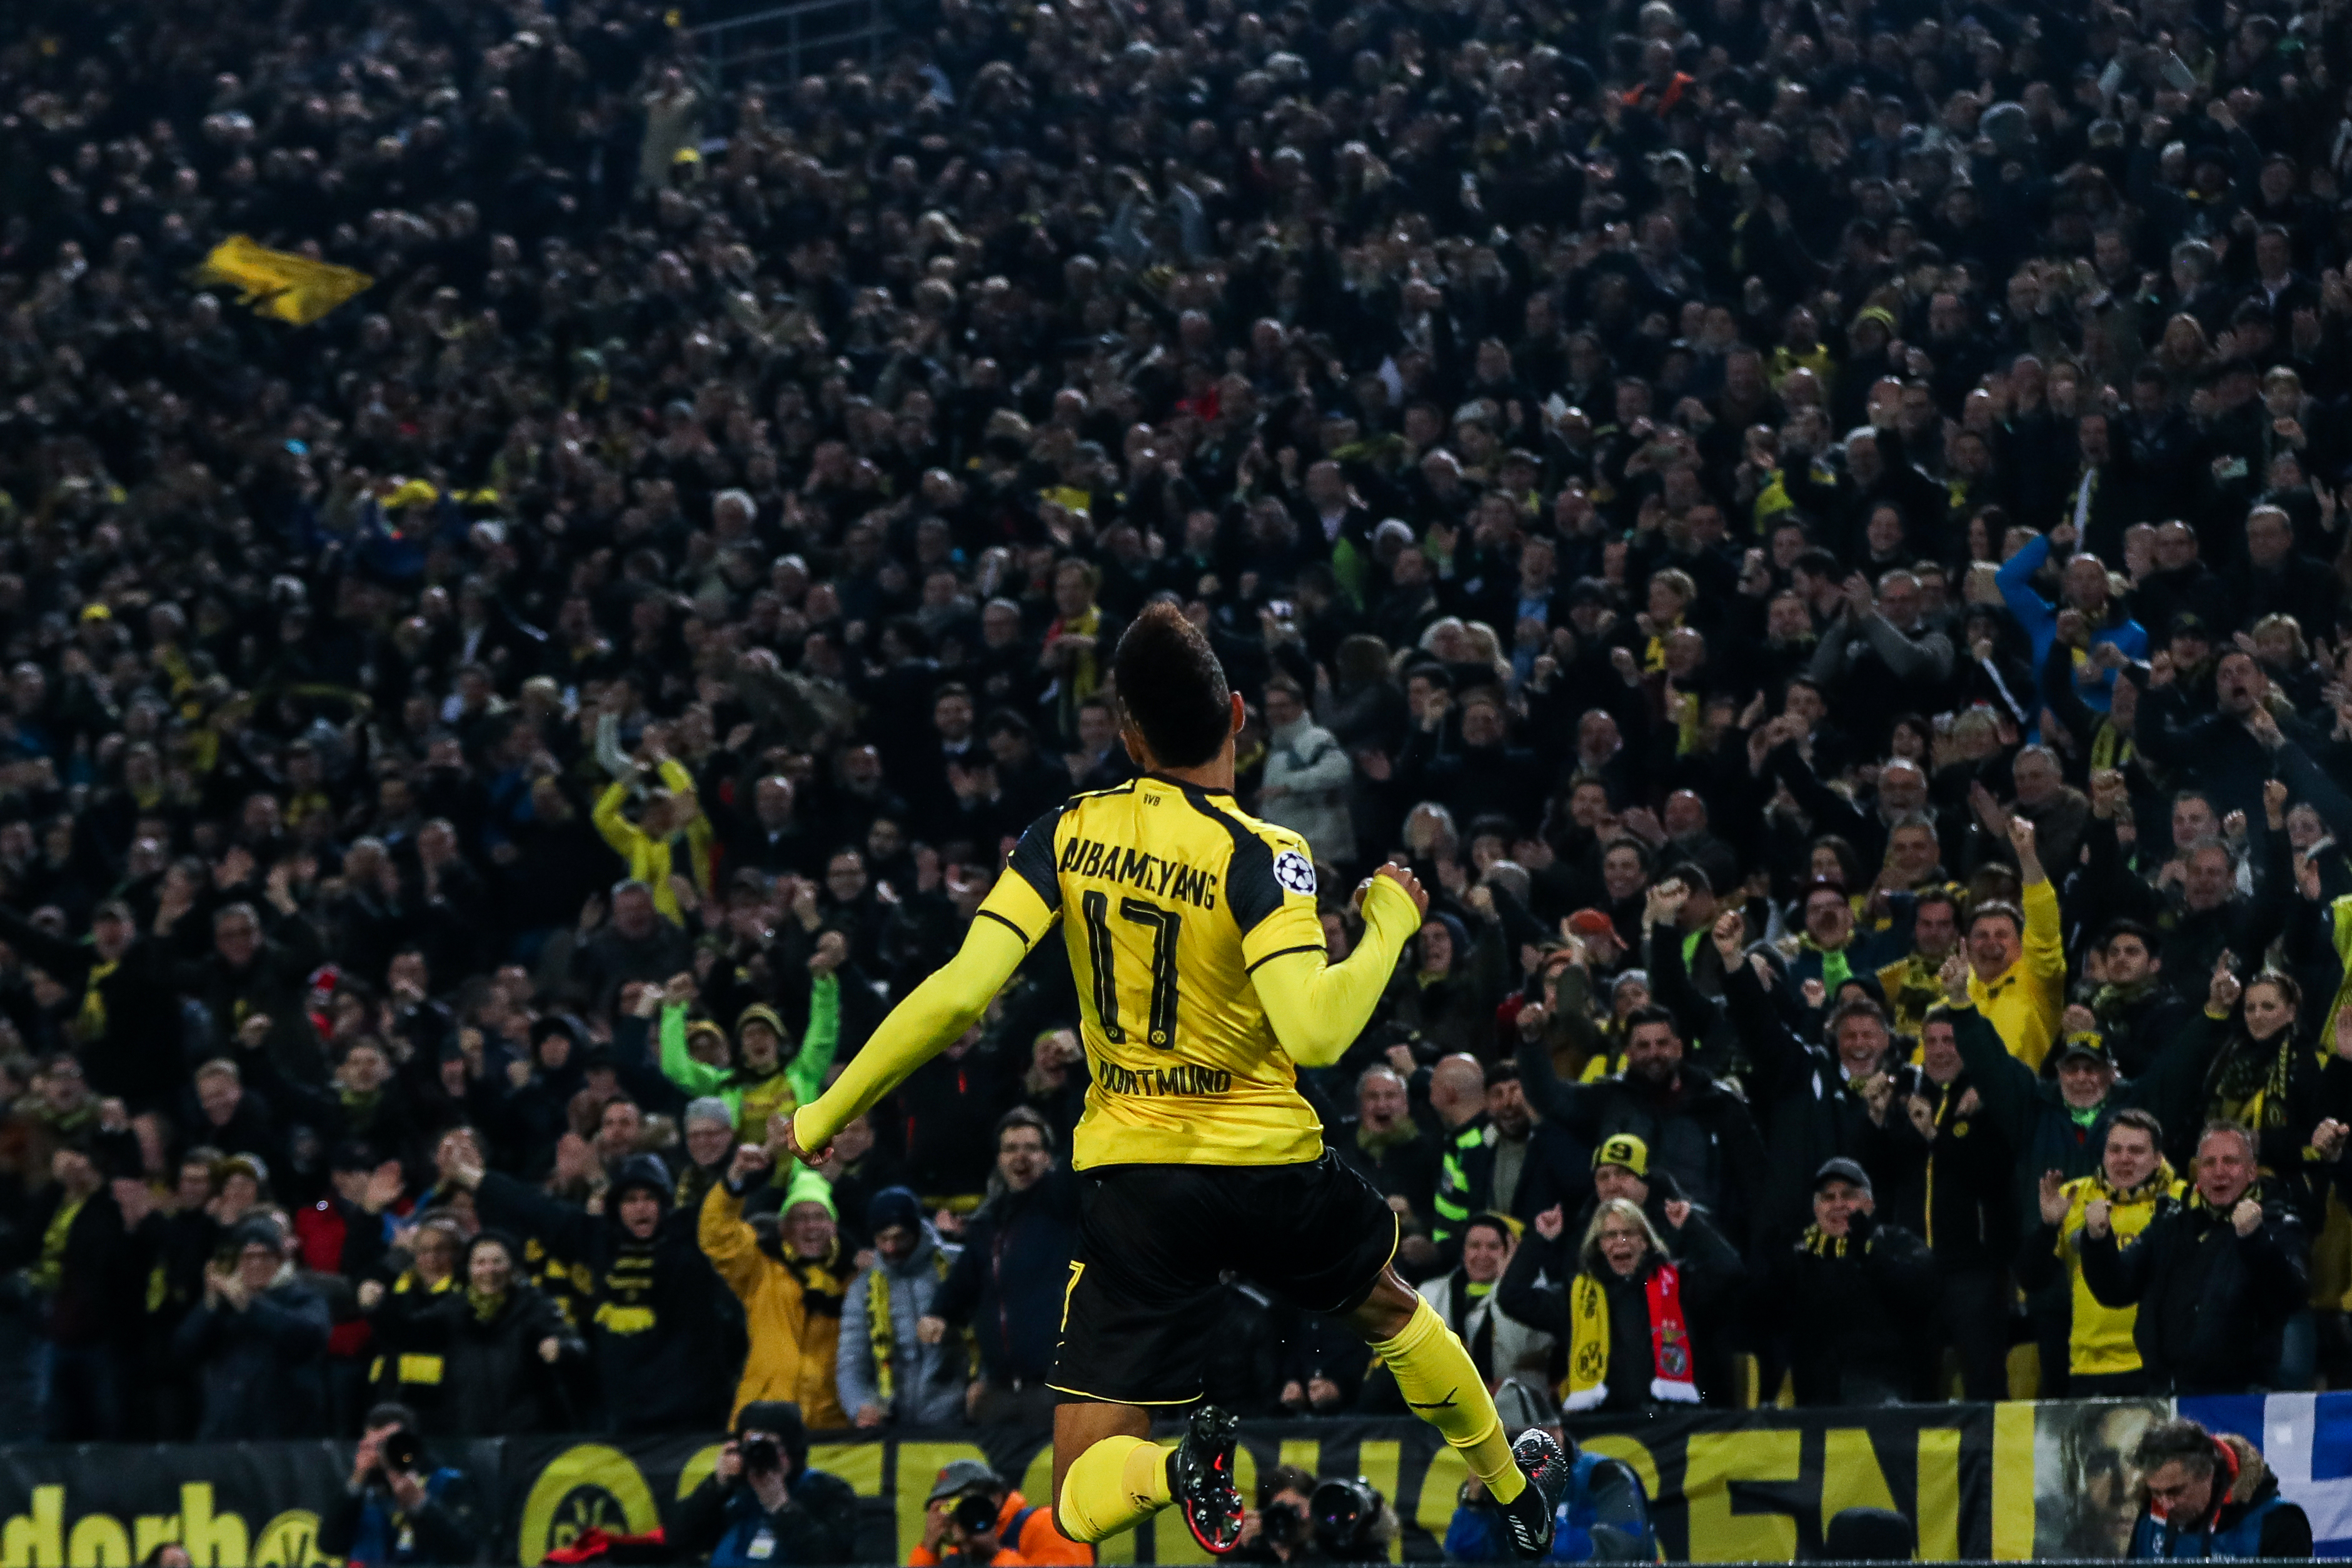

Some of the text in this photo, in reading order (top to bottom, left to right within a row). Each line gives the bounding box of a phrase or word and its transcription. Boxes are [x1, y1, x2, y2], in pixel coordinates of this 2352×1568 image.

[1143, 793, 1161, 807] BVB
[1058, 837, 1217, 911] AUBAMEYANG
[1082, 890, 1182, 1050] 17
[1098, 1060, 1232, 1097] DORTMUND
